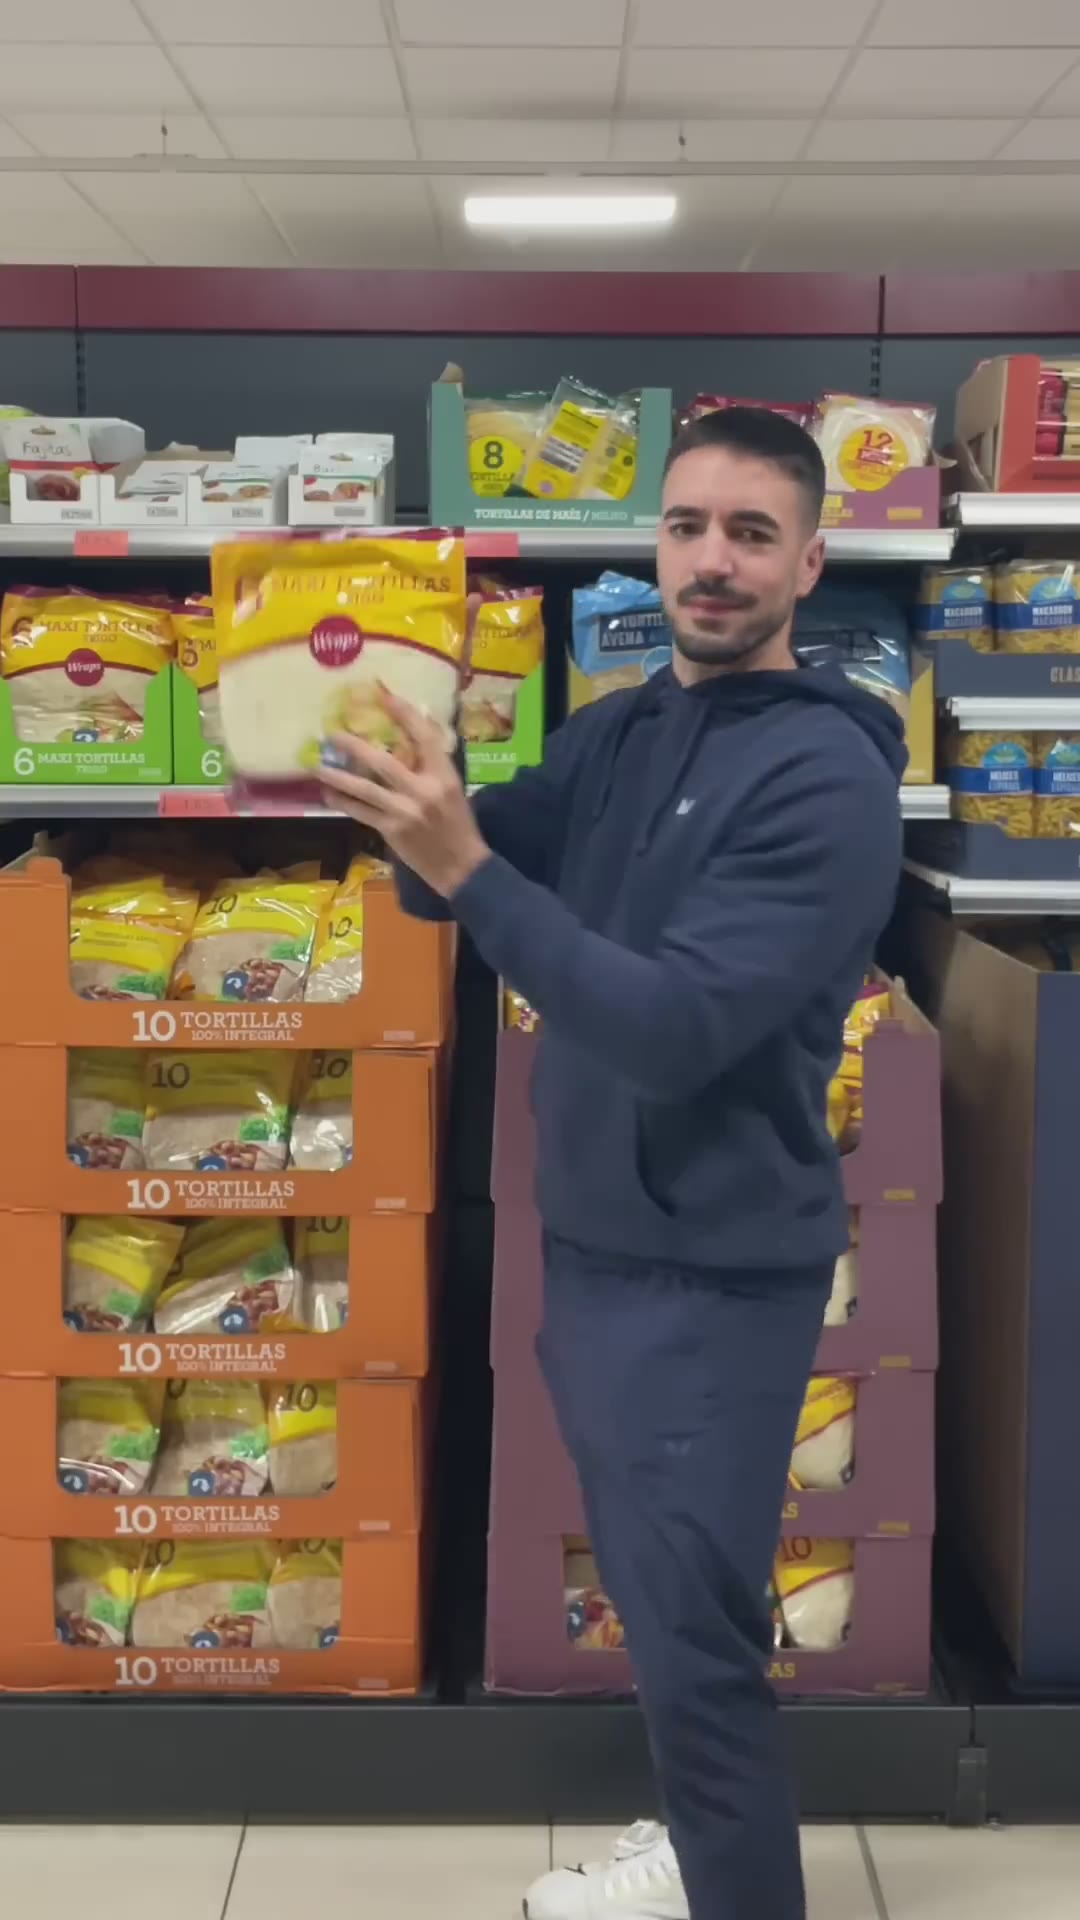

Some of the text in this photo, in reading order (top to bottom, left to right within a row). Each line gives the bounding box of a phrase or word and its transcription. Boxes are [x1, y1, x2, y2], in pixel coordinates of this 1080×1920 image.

[863, 430, 894, 448] 12
[483, 440, 504, 469] 8
[474, 508, 533, 521] TORTILLAS
[535, 509, 550, 521] DE
[601, 631, 645, 648] AVENA
[67, 661, 101, 674] Wraps
[14, 747, 35, 776] 6
[38, 752, 145, 764] MAXI TORTILLAS
[202, 750, 222, 777] 6
[206, 894, 238, 916] 10
[328, 916, 353, 940] 10
[132, 1010, 176, 1042] 10
[180, 1011, 303, 1029] TORTILLAS
[191, 1029, 294, 1041] 100% INTEGRAL
[151, 1062, 190, 1089] 10
[312, 1056, 349, 1080] 10
[127, 1178, 171, 1210] 10
[174, 1179, 295, 1197] TORTILLAS
[218, 1198, 287, 1209] INTEGRAL
[118, 1342, 162, 1373] 10
[166, 1343, 287, 1360] TORTILLAS
[209, 1361, 277, 1372] INTEGRAL
[279, 1383, 318, 1413] 10
[114, 1504, 157, 1534] 10
[160, 1505, 280, 1521] TORTILLAS
[204, 1522, 272, 1533] INTEGRAL
[114, 1656, 158, 1686] 10
[161, 1657, 280, 1674] TORTILLAS
